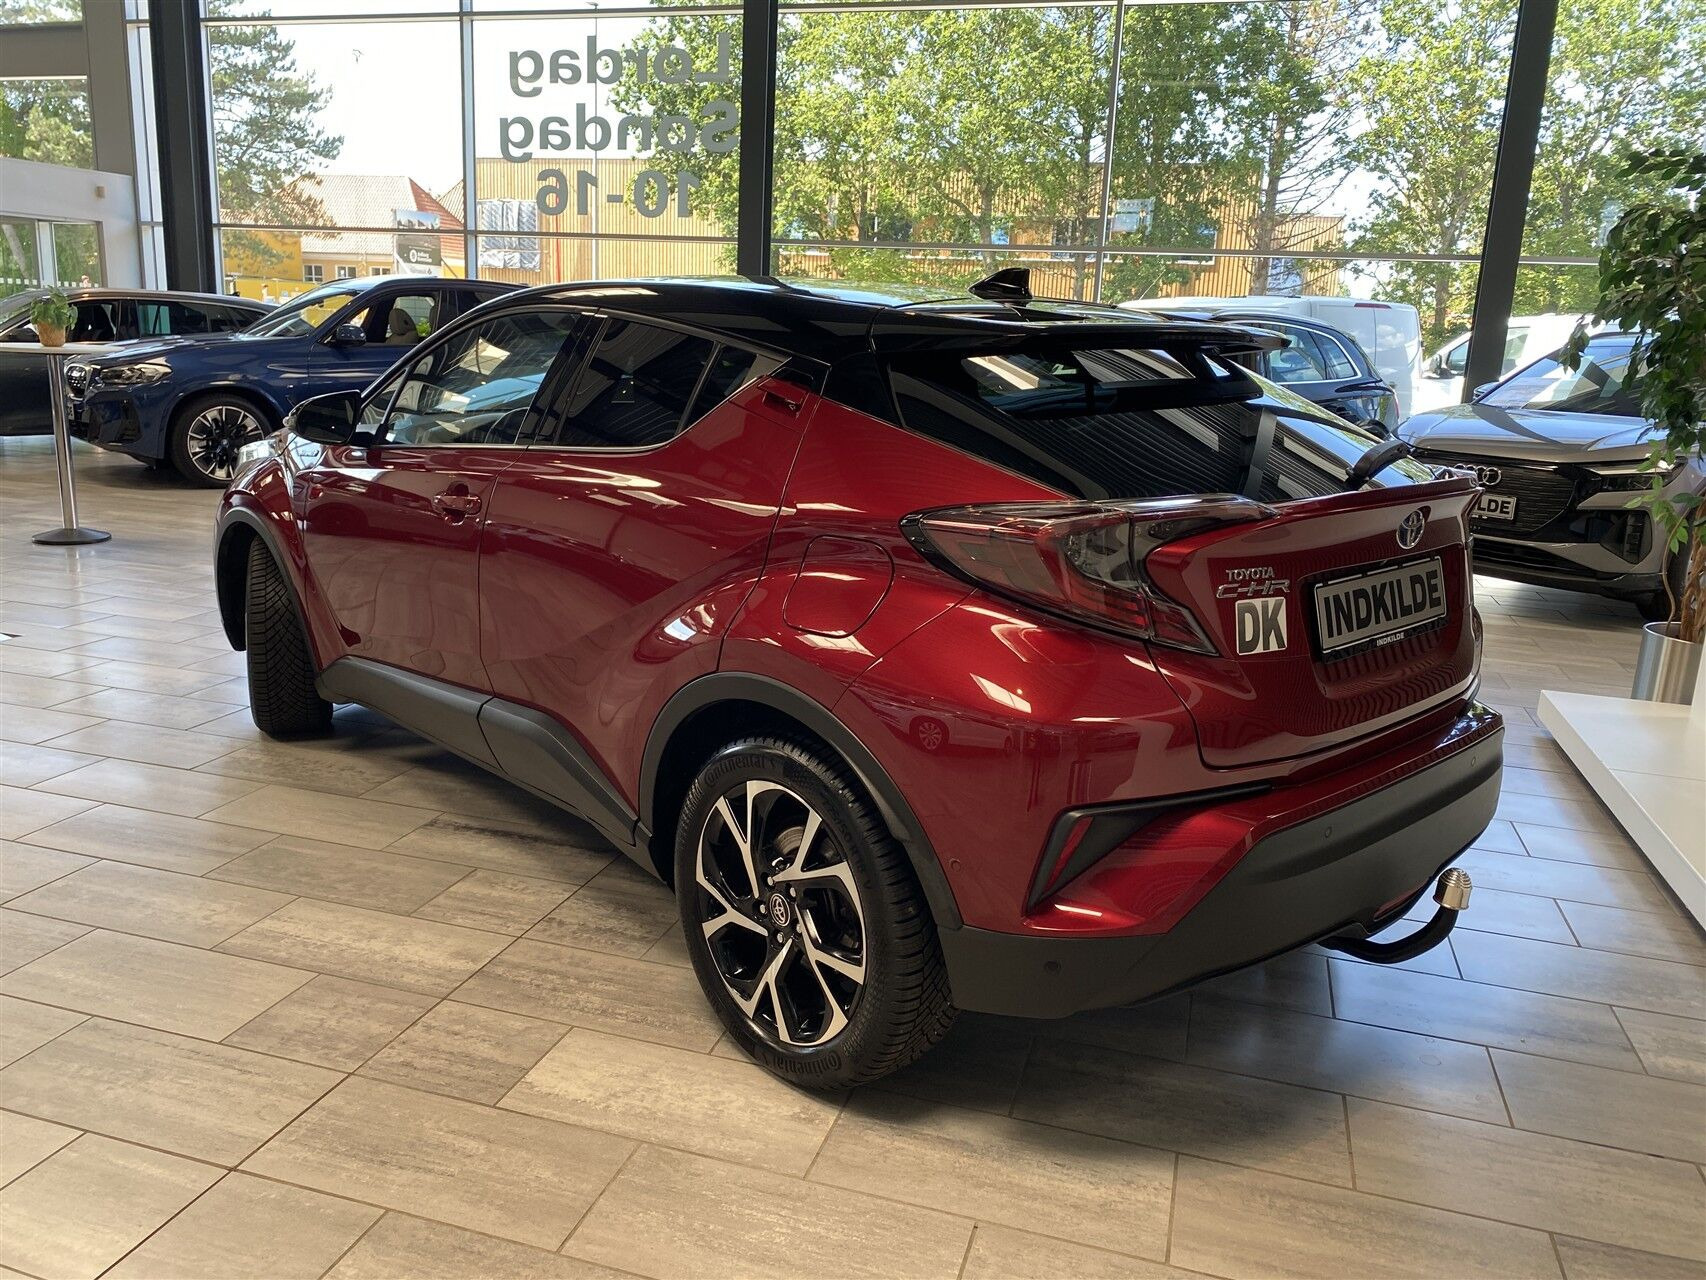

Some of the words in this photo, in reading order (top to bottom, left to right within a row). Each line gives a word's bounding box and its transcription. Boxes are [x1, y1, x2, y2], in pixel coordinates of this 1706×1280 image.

[1225, 566, 1275, 581] TOYOTA
[1216, 580, 1290, 598] C-HR
[1323, 569, 1442, 639] INDKILDE
[1237, 598, 1286, 654] DK
[1376, 632, 1405, 647] INDKILDE
[704, 753, 766, 788] Continental
